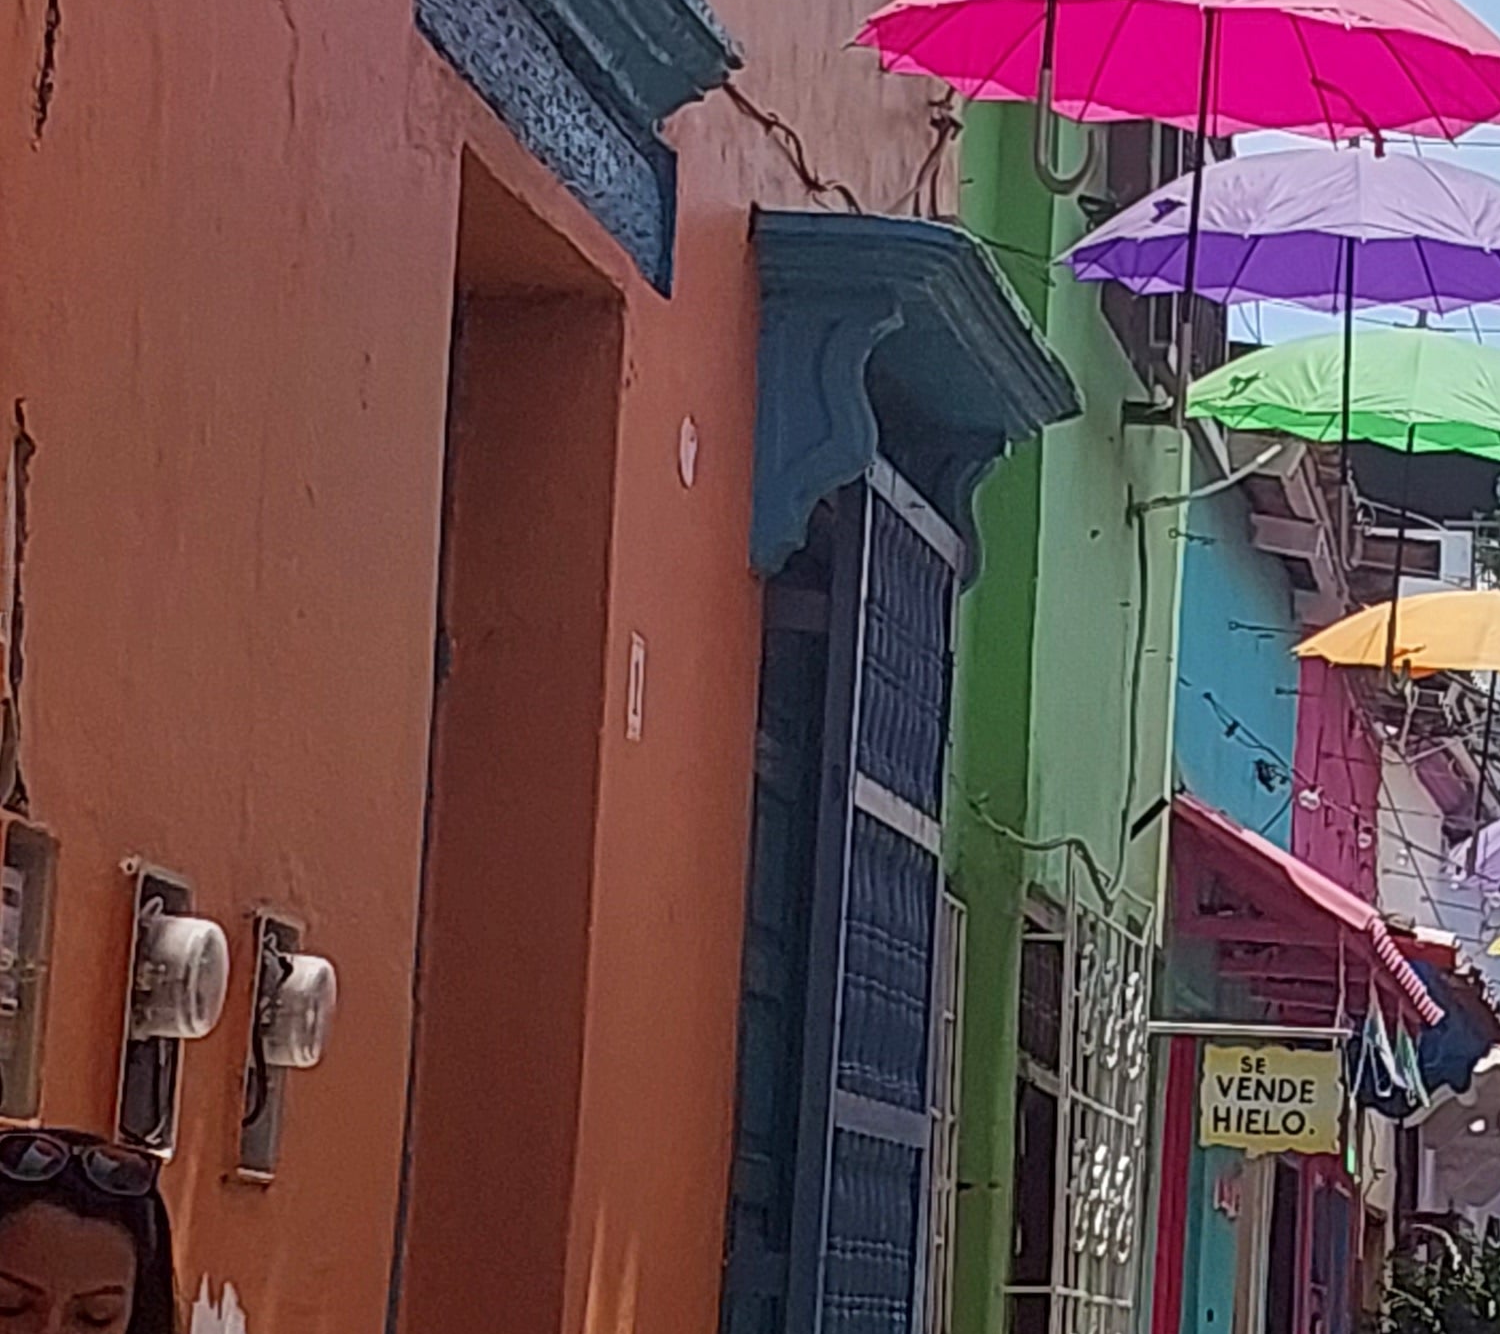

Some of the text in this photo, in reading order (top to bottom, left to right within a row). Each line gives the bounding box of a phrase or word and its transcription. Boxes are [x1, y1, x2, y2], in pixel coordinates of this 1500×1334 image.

[1240, 1055, 1267, 1074] SE
[1216, 1075, 1315, 1104] VENDE
[1213, 1105, 1316, 1135] HIELO.
